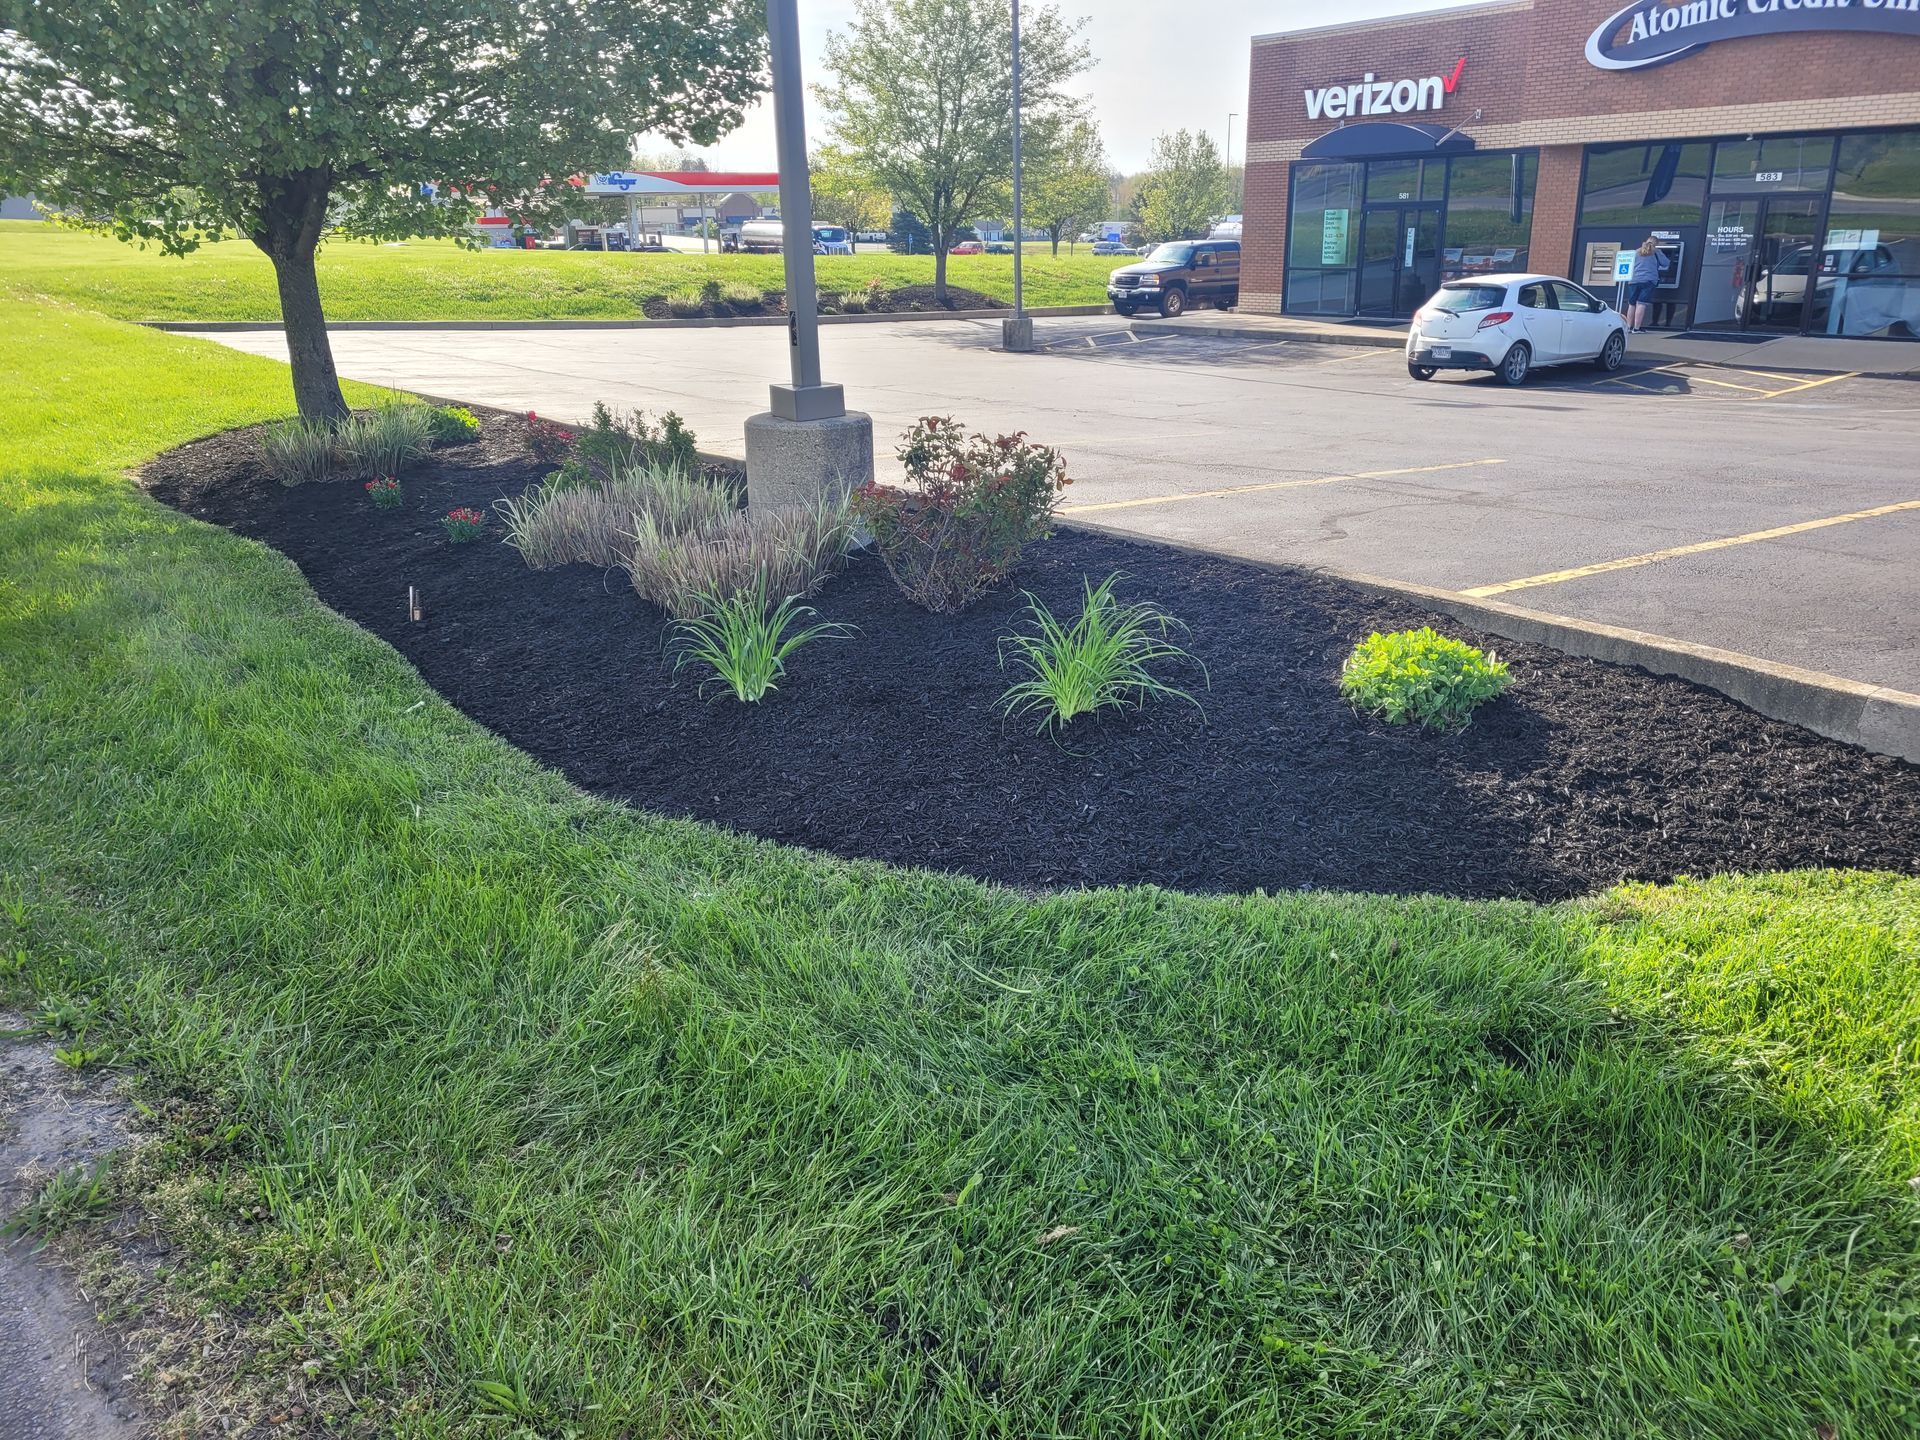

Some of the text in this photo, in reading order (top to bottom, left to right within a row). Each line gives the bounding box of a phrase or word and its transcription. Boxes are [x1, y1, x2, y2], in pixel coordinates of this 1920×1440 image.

[1627, 0, 1737, 45] Atomic
[1304, 73, 1444, 120] verizon
[1760, 173, 1778, 181] 583
[1398, 192, 1409, 200] 581
